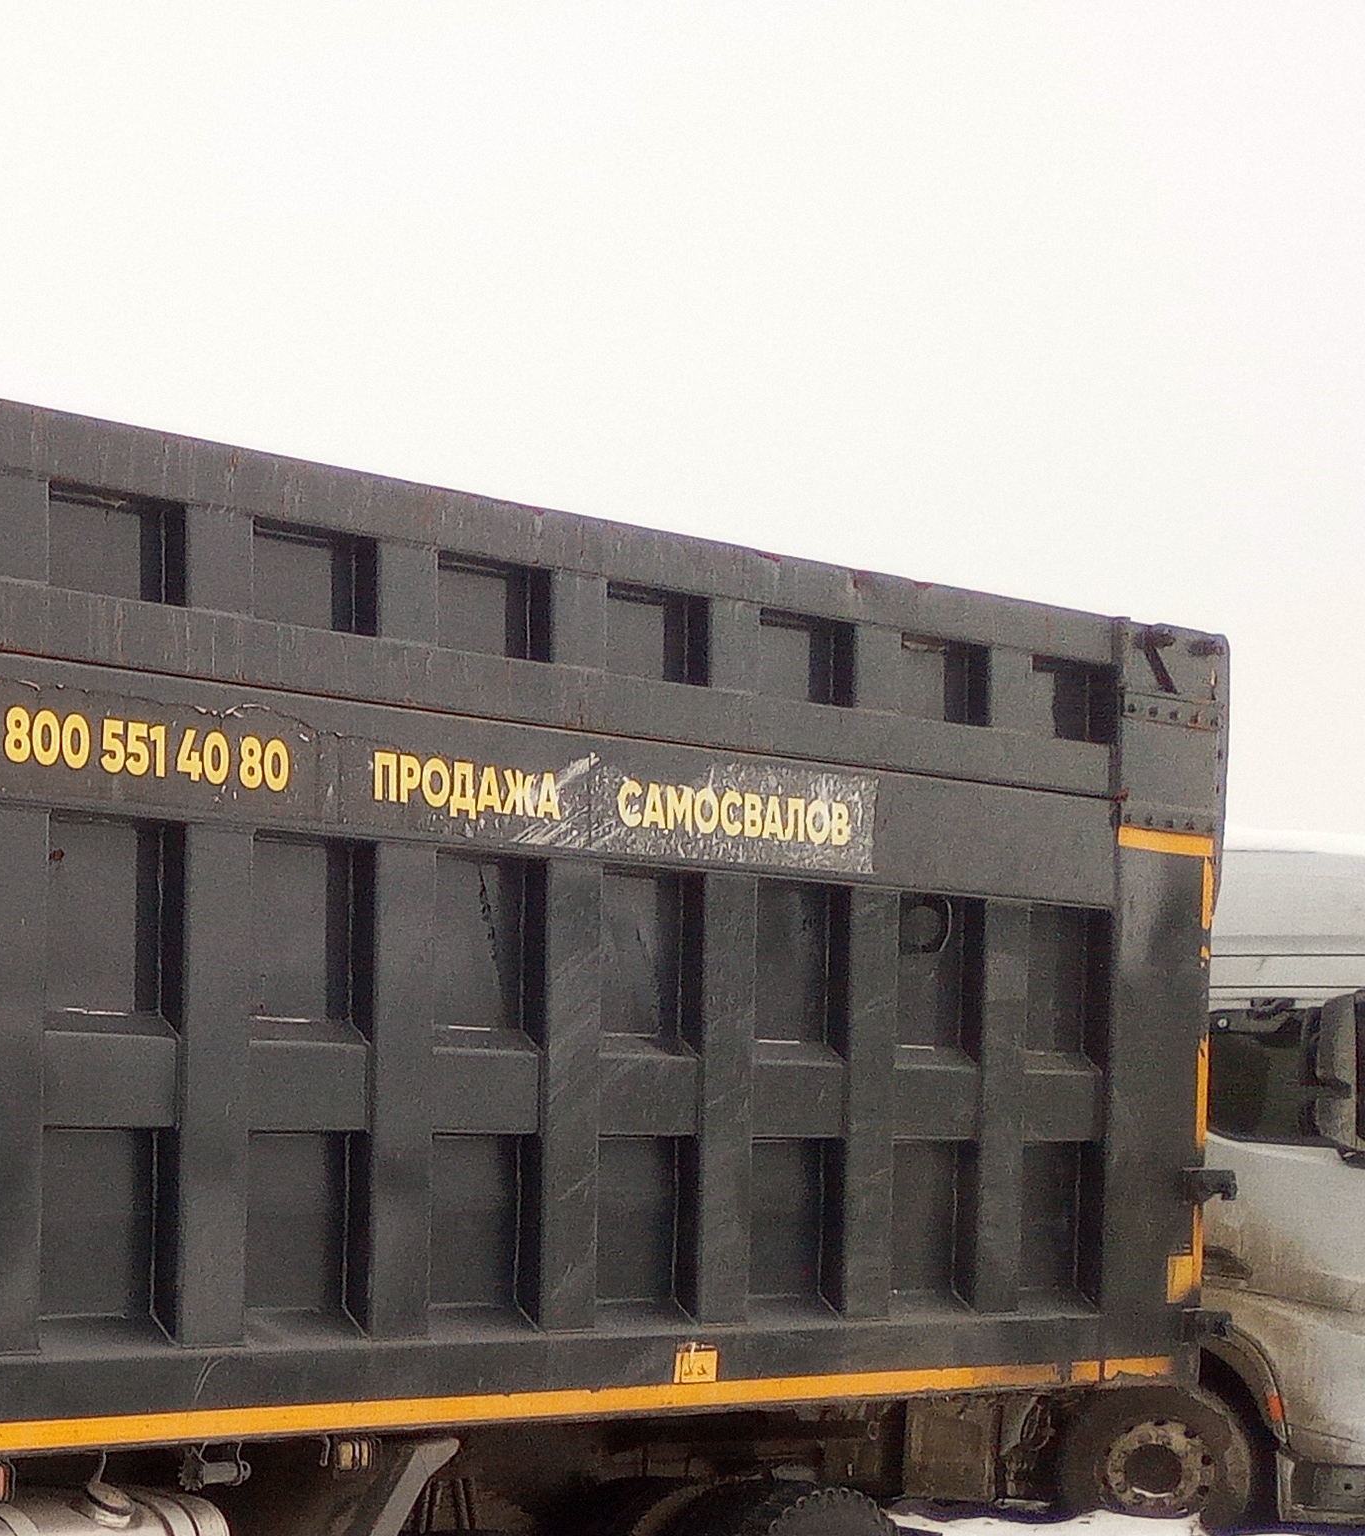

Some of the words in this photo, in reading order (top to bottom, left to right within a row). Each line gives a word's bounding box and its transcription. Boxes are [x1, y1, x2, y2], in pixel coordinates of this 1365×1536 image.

[4, 705, 91, 770] 800
[100, 717, 166, 778] 551
[176, 728, 230, 786] 40
[238, 736, 290, 793] 80
[372, 750, 562, 821] ПРОДАЖА
[616, 779, 852, 847] САМОСВАЛОВ
